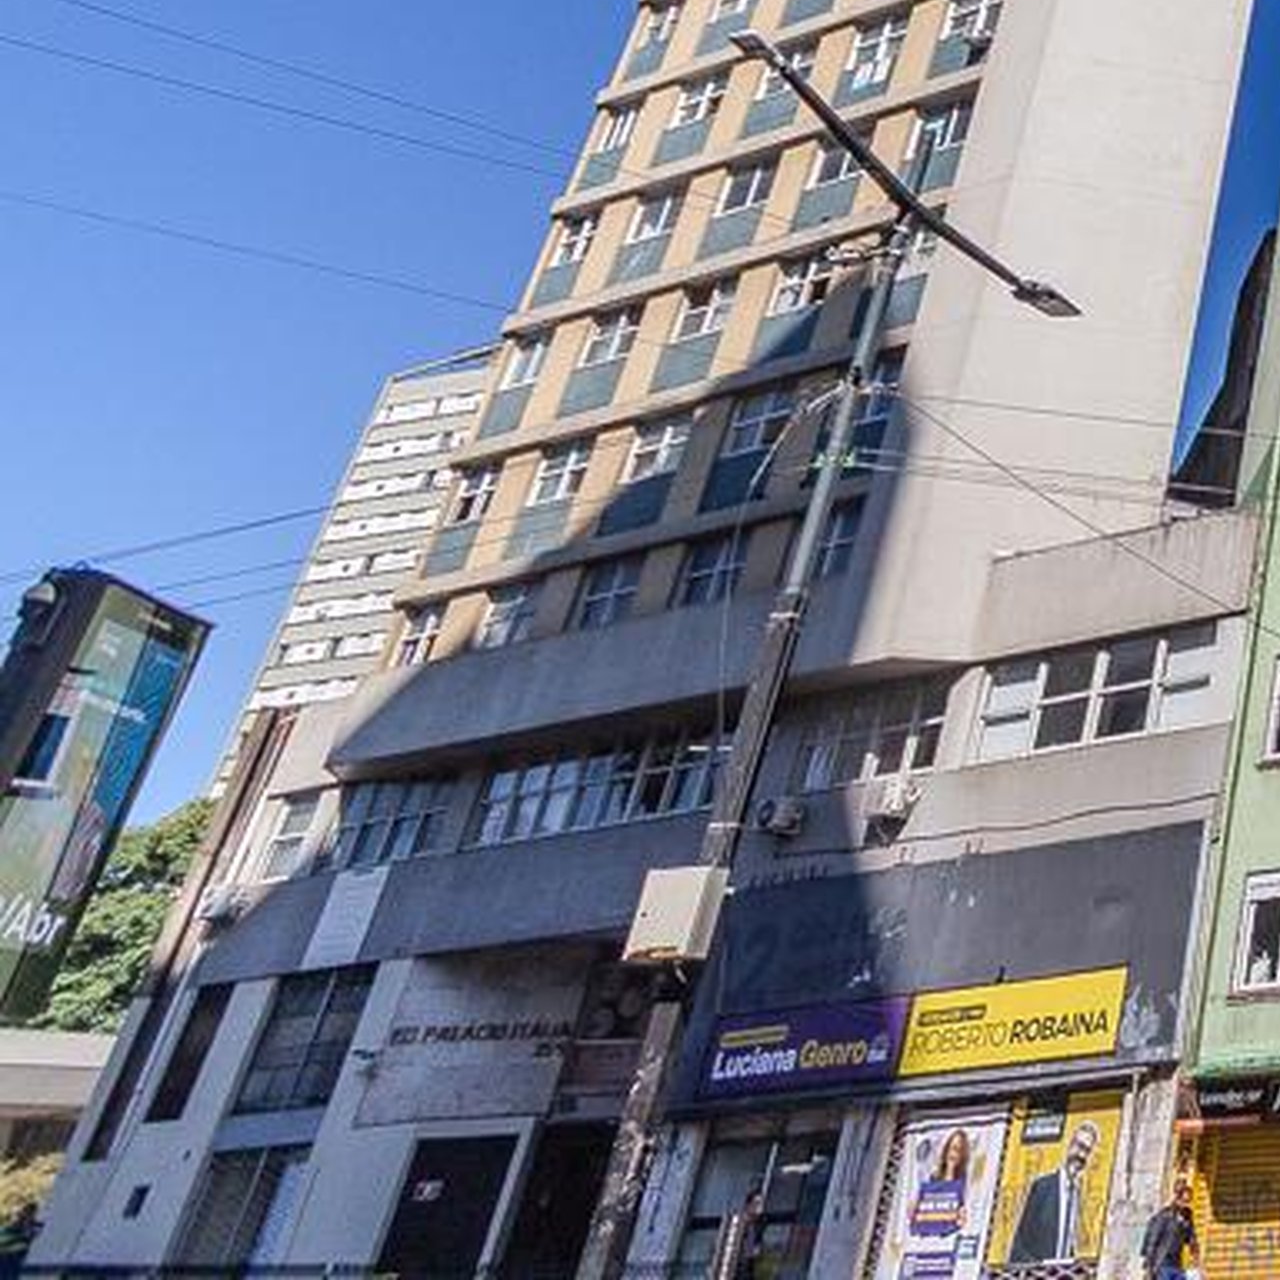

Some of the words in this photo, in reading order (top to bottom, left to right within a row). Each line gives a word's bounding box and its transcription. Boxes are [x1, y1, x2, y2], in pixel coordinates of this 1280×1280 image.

[909, 1021, 1008, 1057] ROBERTO
[1009, 1010, 1109, 1044] ROBAINA
[711, 1047, 797, 1080] Luciana
[800, 1039, 867, 1068] Genro
